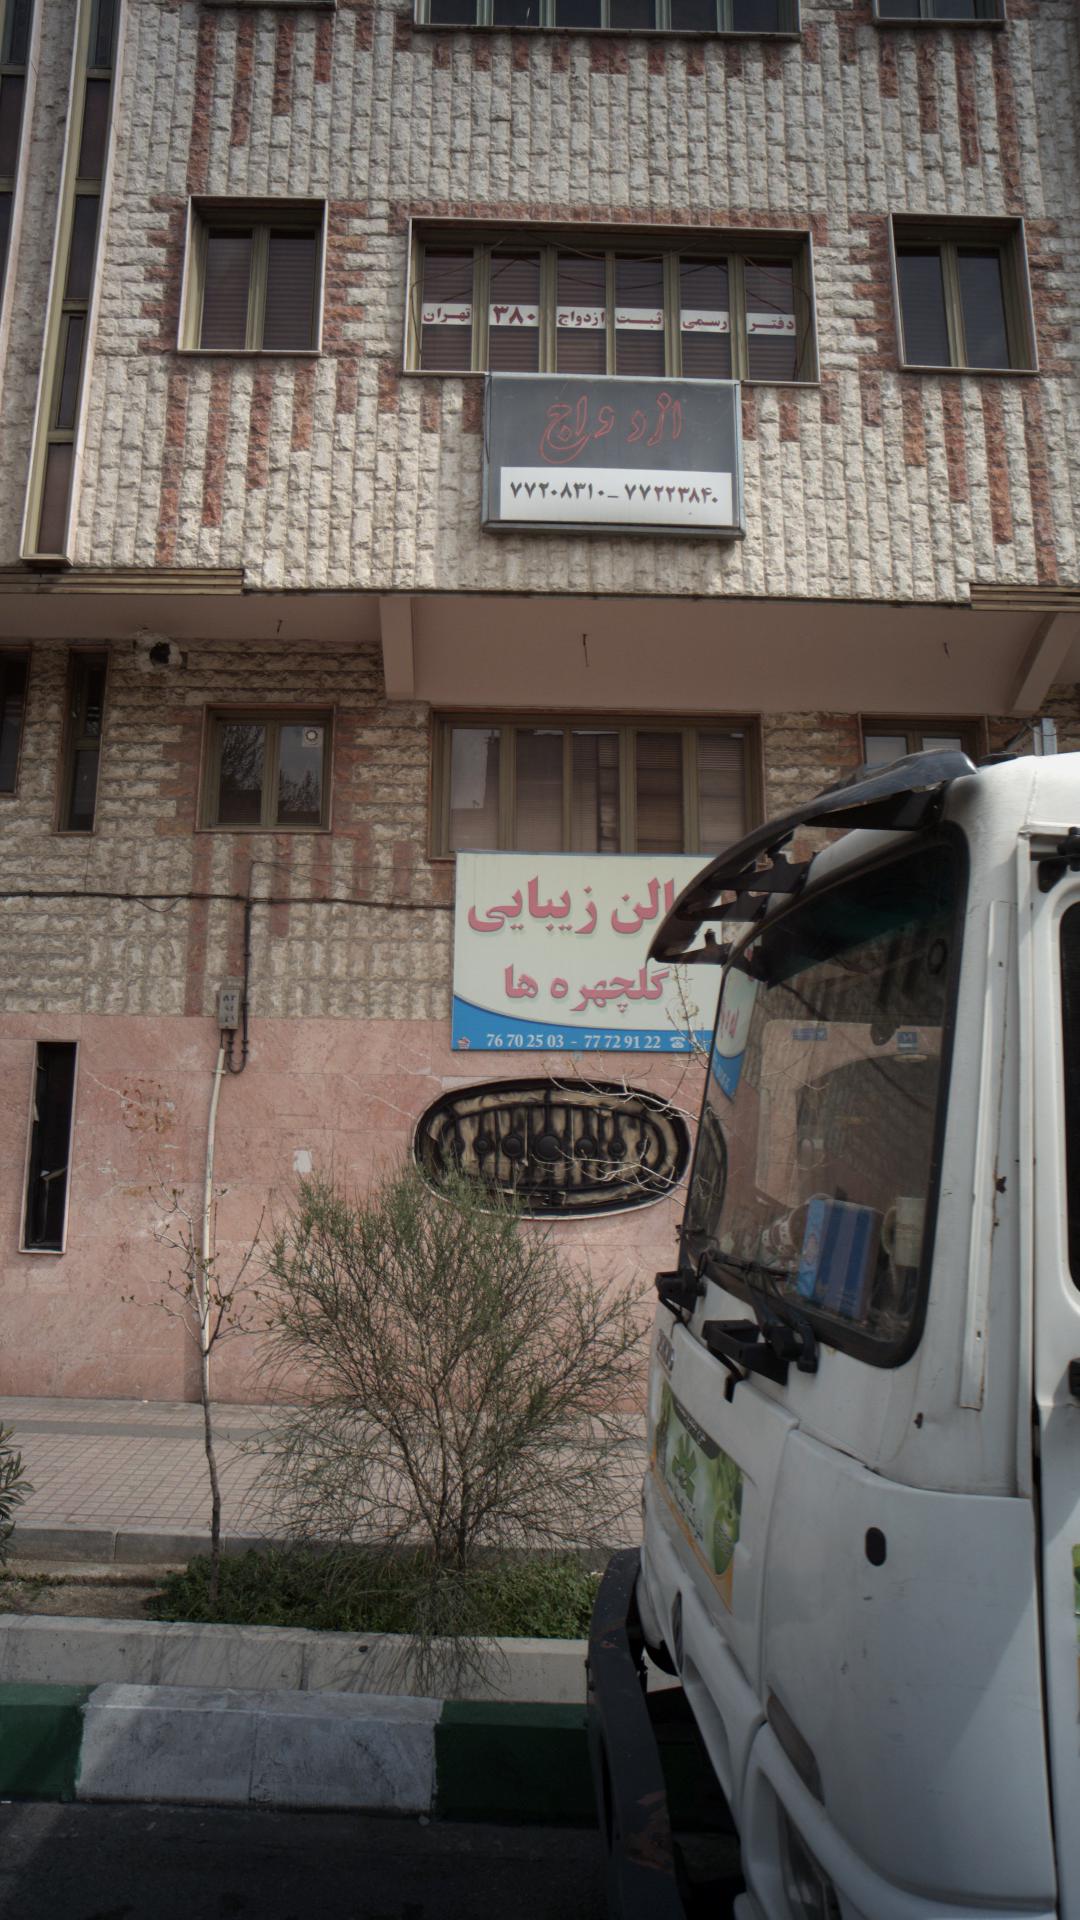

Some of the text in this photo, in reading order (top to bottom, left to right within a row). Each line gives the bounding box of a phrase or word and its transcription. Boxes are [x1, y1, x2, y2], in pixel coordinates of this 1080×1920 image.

[423, 305, 794, 332] دفتر رسمی ثبت ازدواج ۳۸۰ تهران
[539, 391, 683, 465] ازدواج
[467, 873, 675, 935] الن زیبایی
